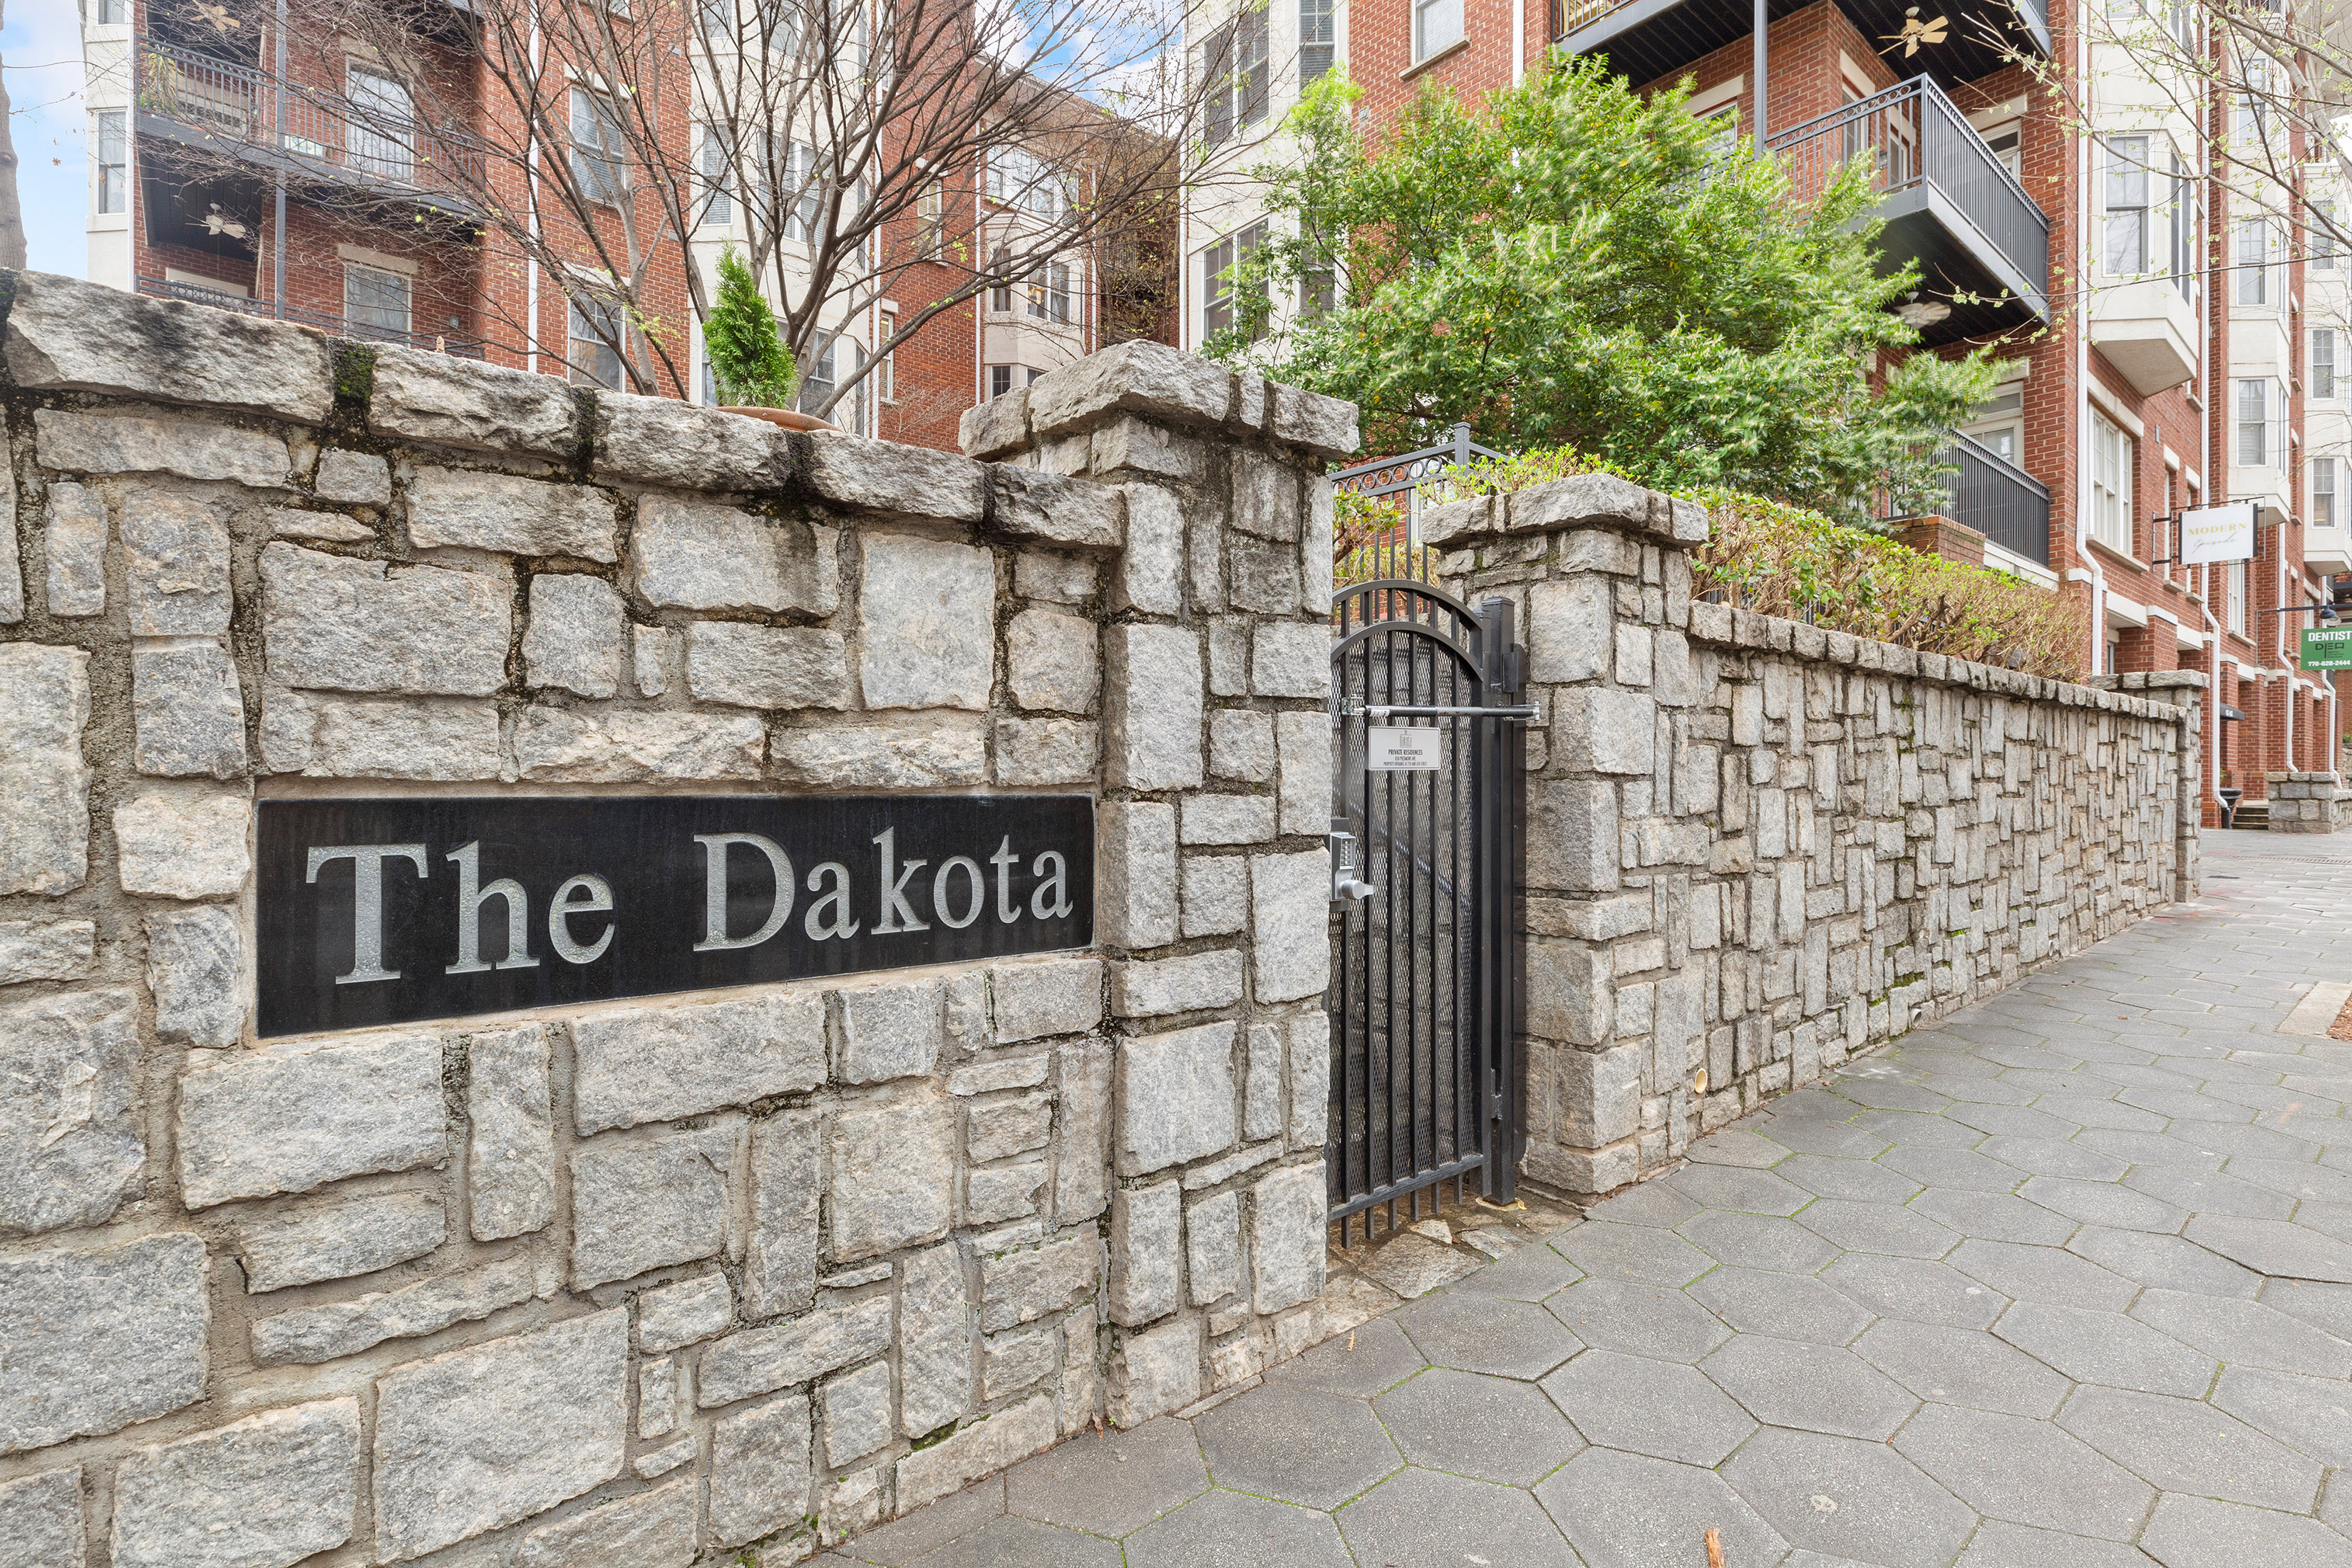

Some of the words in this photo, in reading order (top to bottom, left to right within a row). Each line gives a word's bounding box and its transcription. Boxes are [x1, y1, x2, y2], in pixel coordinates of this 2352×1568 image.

[2188, 522, 2247, 536] MODERN
[2308, 631, 2352, 641] DENTIST
[306, 840, 615, 985] The
[693, 826, 1073, 951] Dakota
